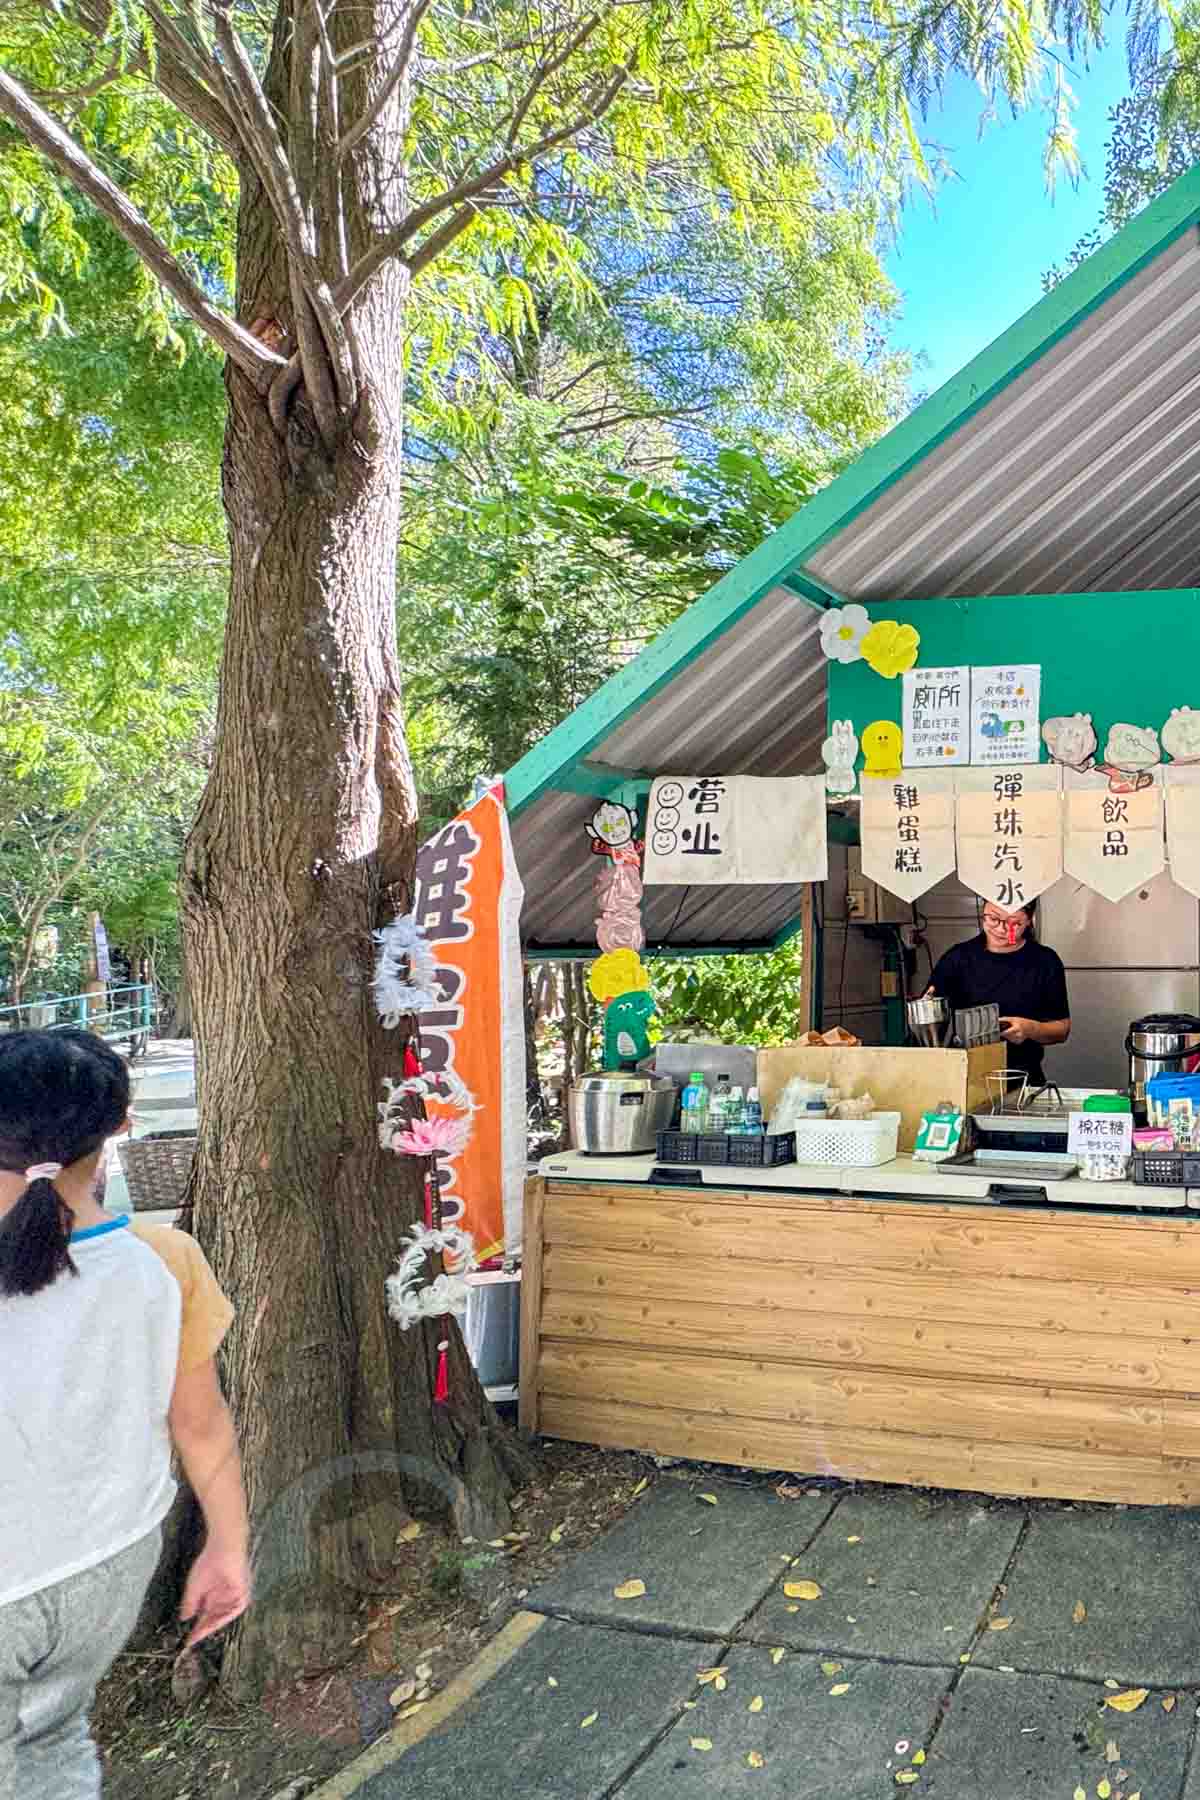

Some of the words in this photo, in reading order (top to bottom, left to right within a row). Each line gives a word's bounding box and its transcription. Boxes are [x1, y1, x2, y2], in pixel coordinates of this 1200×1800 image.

[913, 684, 961, 710] 廁所
[893, 783, 923, 873] 雞蛋糕
[993, 773, 1026, 906] 彈珠汽水
[1101, 796, 1130, 857] 飲品
[1078, 1119, 1125, 1136] 棉花糖
